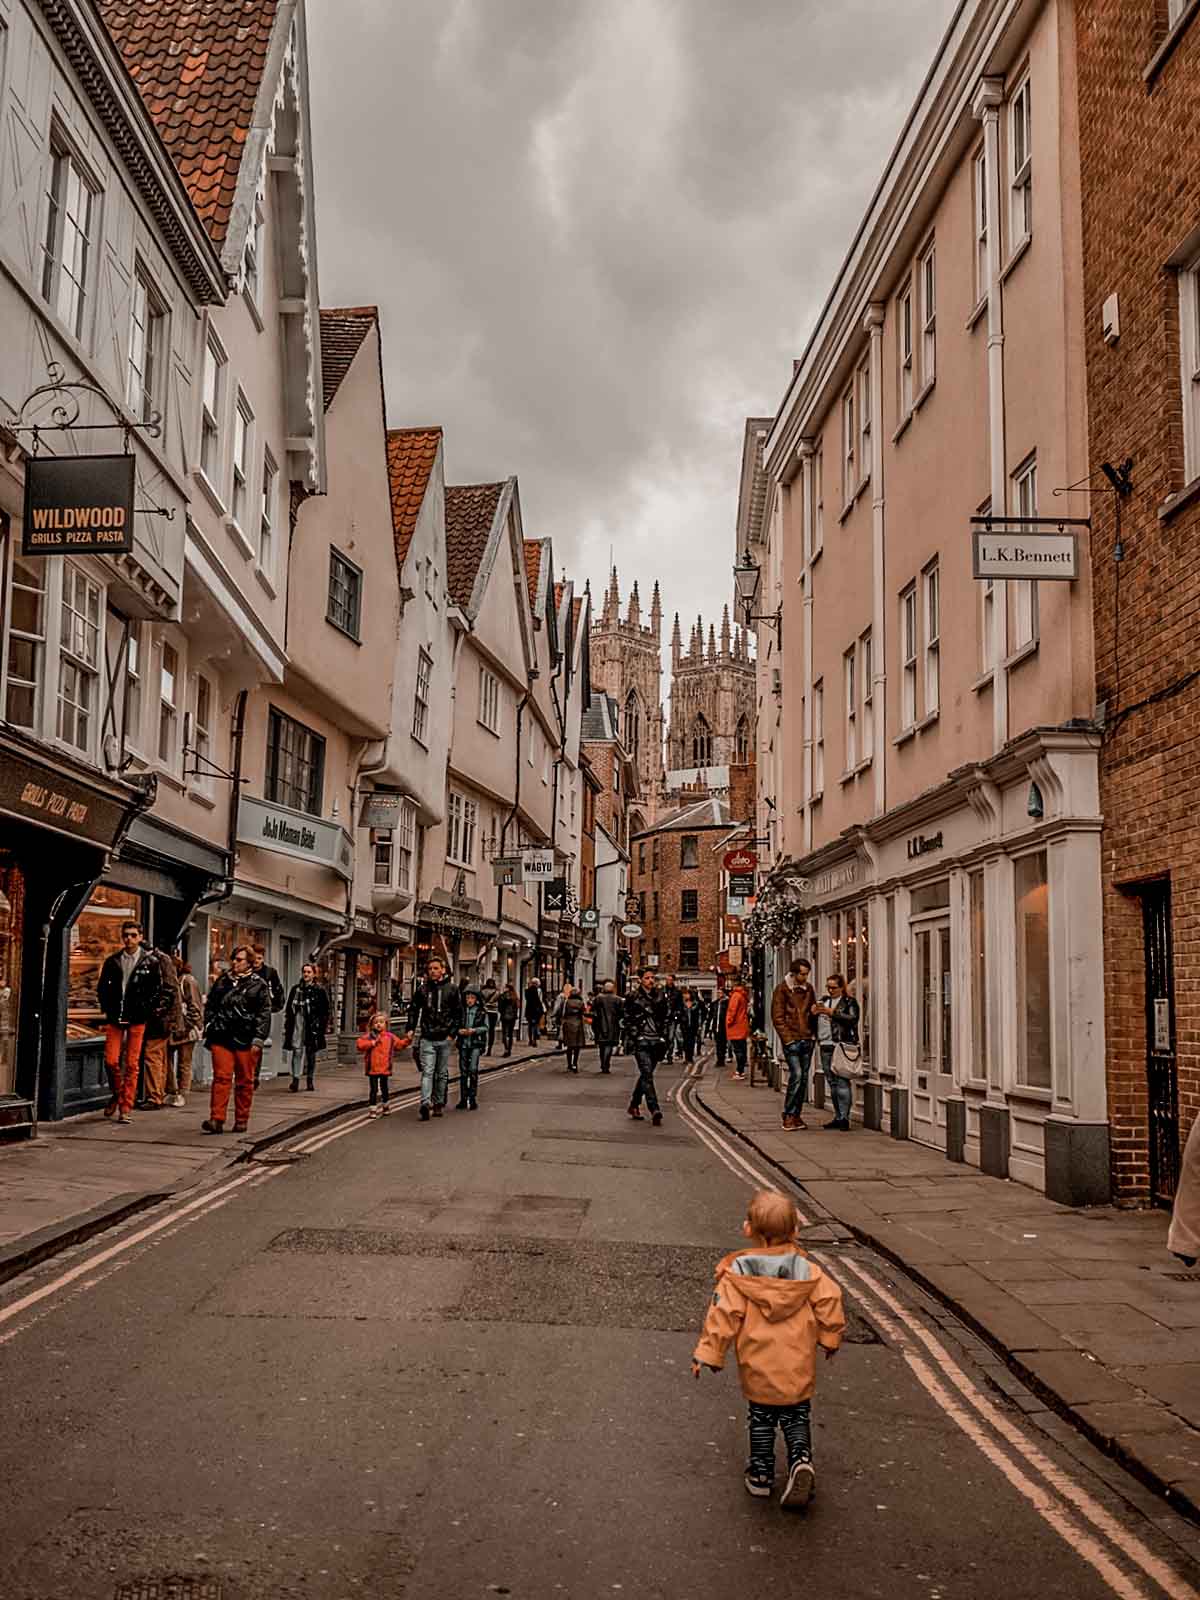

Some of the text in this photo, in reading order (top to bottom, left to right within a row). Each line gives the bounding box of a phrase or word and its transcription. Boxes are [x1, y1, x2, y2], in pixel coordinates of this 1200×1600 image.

[32, 507, 125, 529] WILDWOOD
[31, 531, 124, 544] GRILLS PIZZA PASTA
[982, 547, 1072, 563] L.K.Bennett
[524, 862, 552, 872] WAGYU
